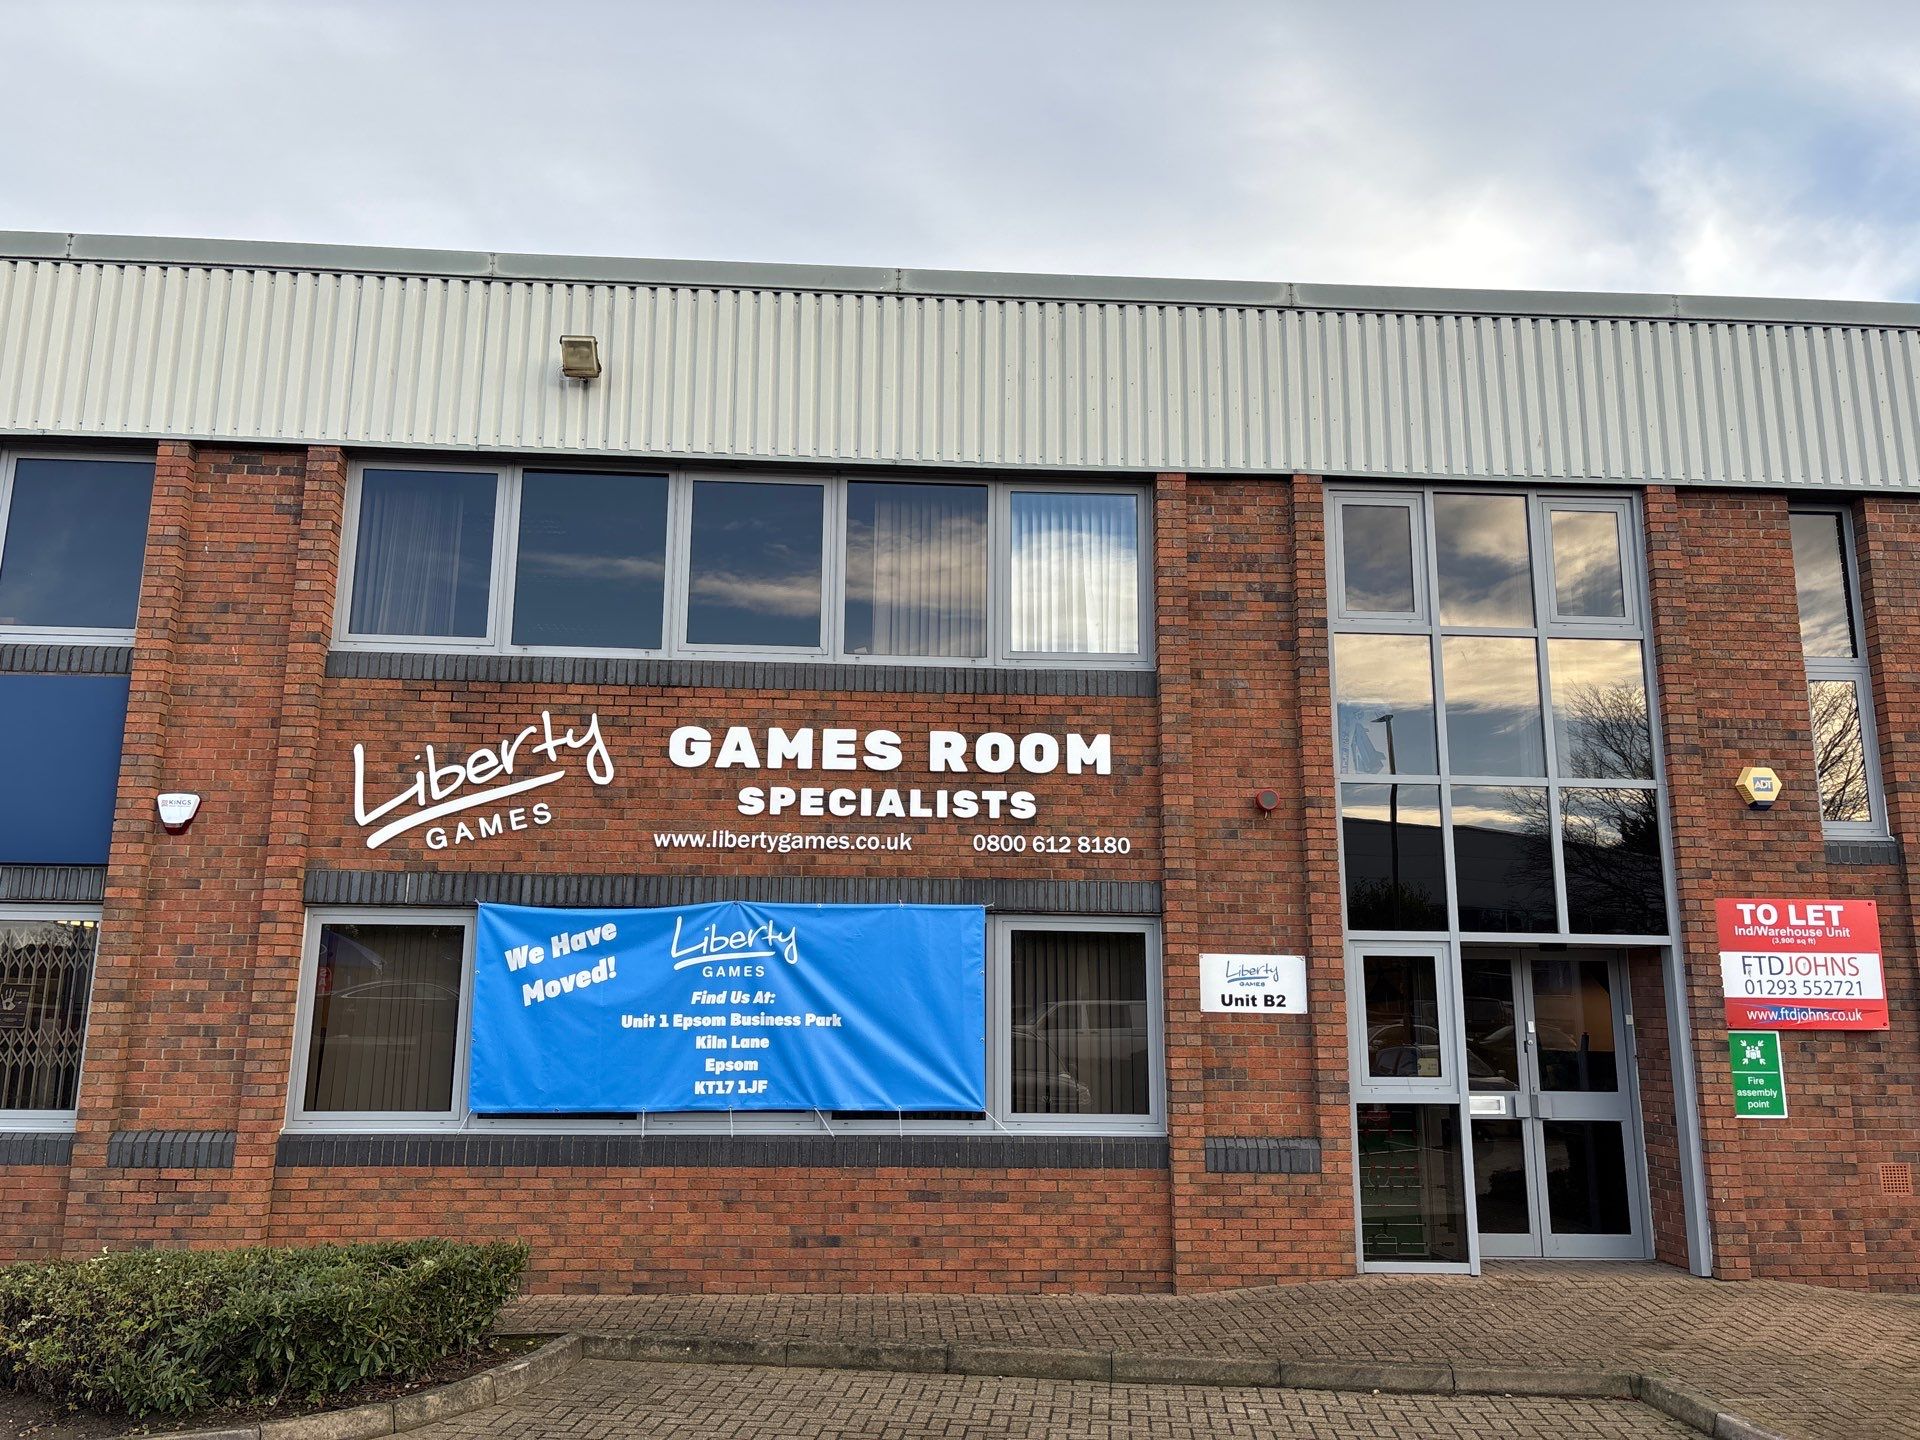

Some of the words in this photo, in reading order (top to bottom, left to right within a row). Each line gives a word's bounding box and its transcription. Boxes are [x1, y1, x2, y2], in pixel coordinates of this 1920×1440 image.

[668, 726, 903, 771] GAMES
[928, 730, 1112, 775] ROOM
[353, 710, 614, 827] Liberty
[1755, 780, 1773, 789] ADT
[737, 786, 1037, 820] SPECIALISTS
[425, 802, 552, 850] GAMES
[653, 829, 912, 854] www.libertygames.co.uk
[973, 834, 1027, 853] 0800
[1032, 835, 1072, 854] 612
[1078, 836, 1131, 855] 8180
[1736, 903, 1778, 926] TO
[1788, 904, 1845, 927] LET
[671, 916, 798, 965] Liberty
[1734, 926, 1823, 938] Ind/Warehouse
[1825, 927, 1851, 938] Unit
[504, 946, 545, 973] We
[550, 921, 618, 959] Have
[1808, 937, 1816, 946] ft)
[702, 965, 766, 979] GAMES
[1226, 961, 1279, 982] Liberty
[1742, 955, 1860, 977] FTDJOHNS
[521, 955, 618, 1008] Moved!
[1744, 979, 1798, 996] 01293
[1803, 980, 1863, 997] 552721
[690, 990, 727, 1006] Find
[730, 991, 750, 1005] Us
[753, 991, 776, 1005] At:
[1220, 993, 1257, 1007] Unit
[1263, 994, 1287, 1008] B2
[621, 1013, 656, 1029] Unit
[659, 1014, 669, 1028] 1
[672, 1014, 727, 1030] Epsom
[730, 1013, 802, 1029] Business
[805, 1013, 843, 1029] Park
[1746, 1007, 1863, 1024] www.ftdjohns.co.uk
[695, 1035, 728, 1050] Kiln
[731, 1035, 770, 1050] Lane
[705, 1057, 759, 1074] Epsom
[693, 1080, 735, 1095] KT17
[737, 1080, 768, 1095] 1JF
[1747, 1076, 1765, 1085] Fire
[1736, 1088, 1778, 1098] assembly
[1747, 1100, 1770, 1109] point
